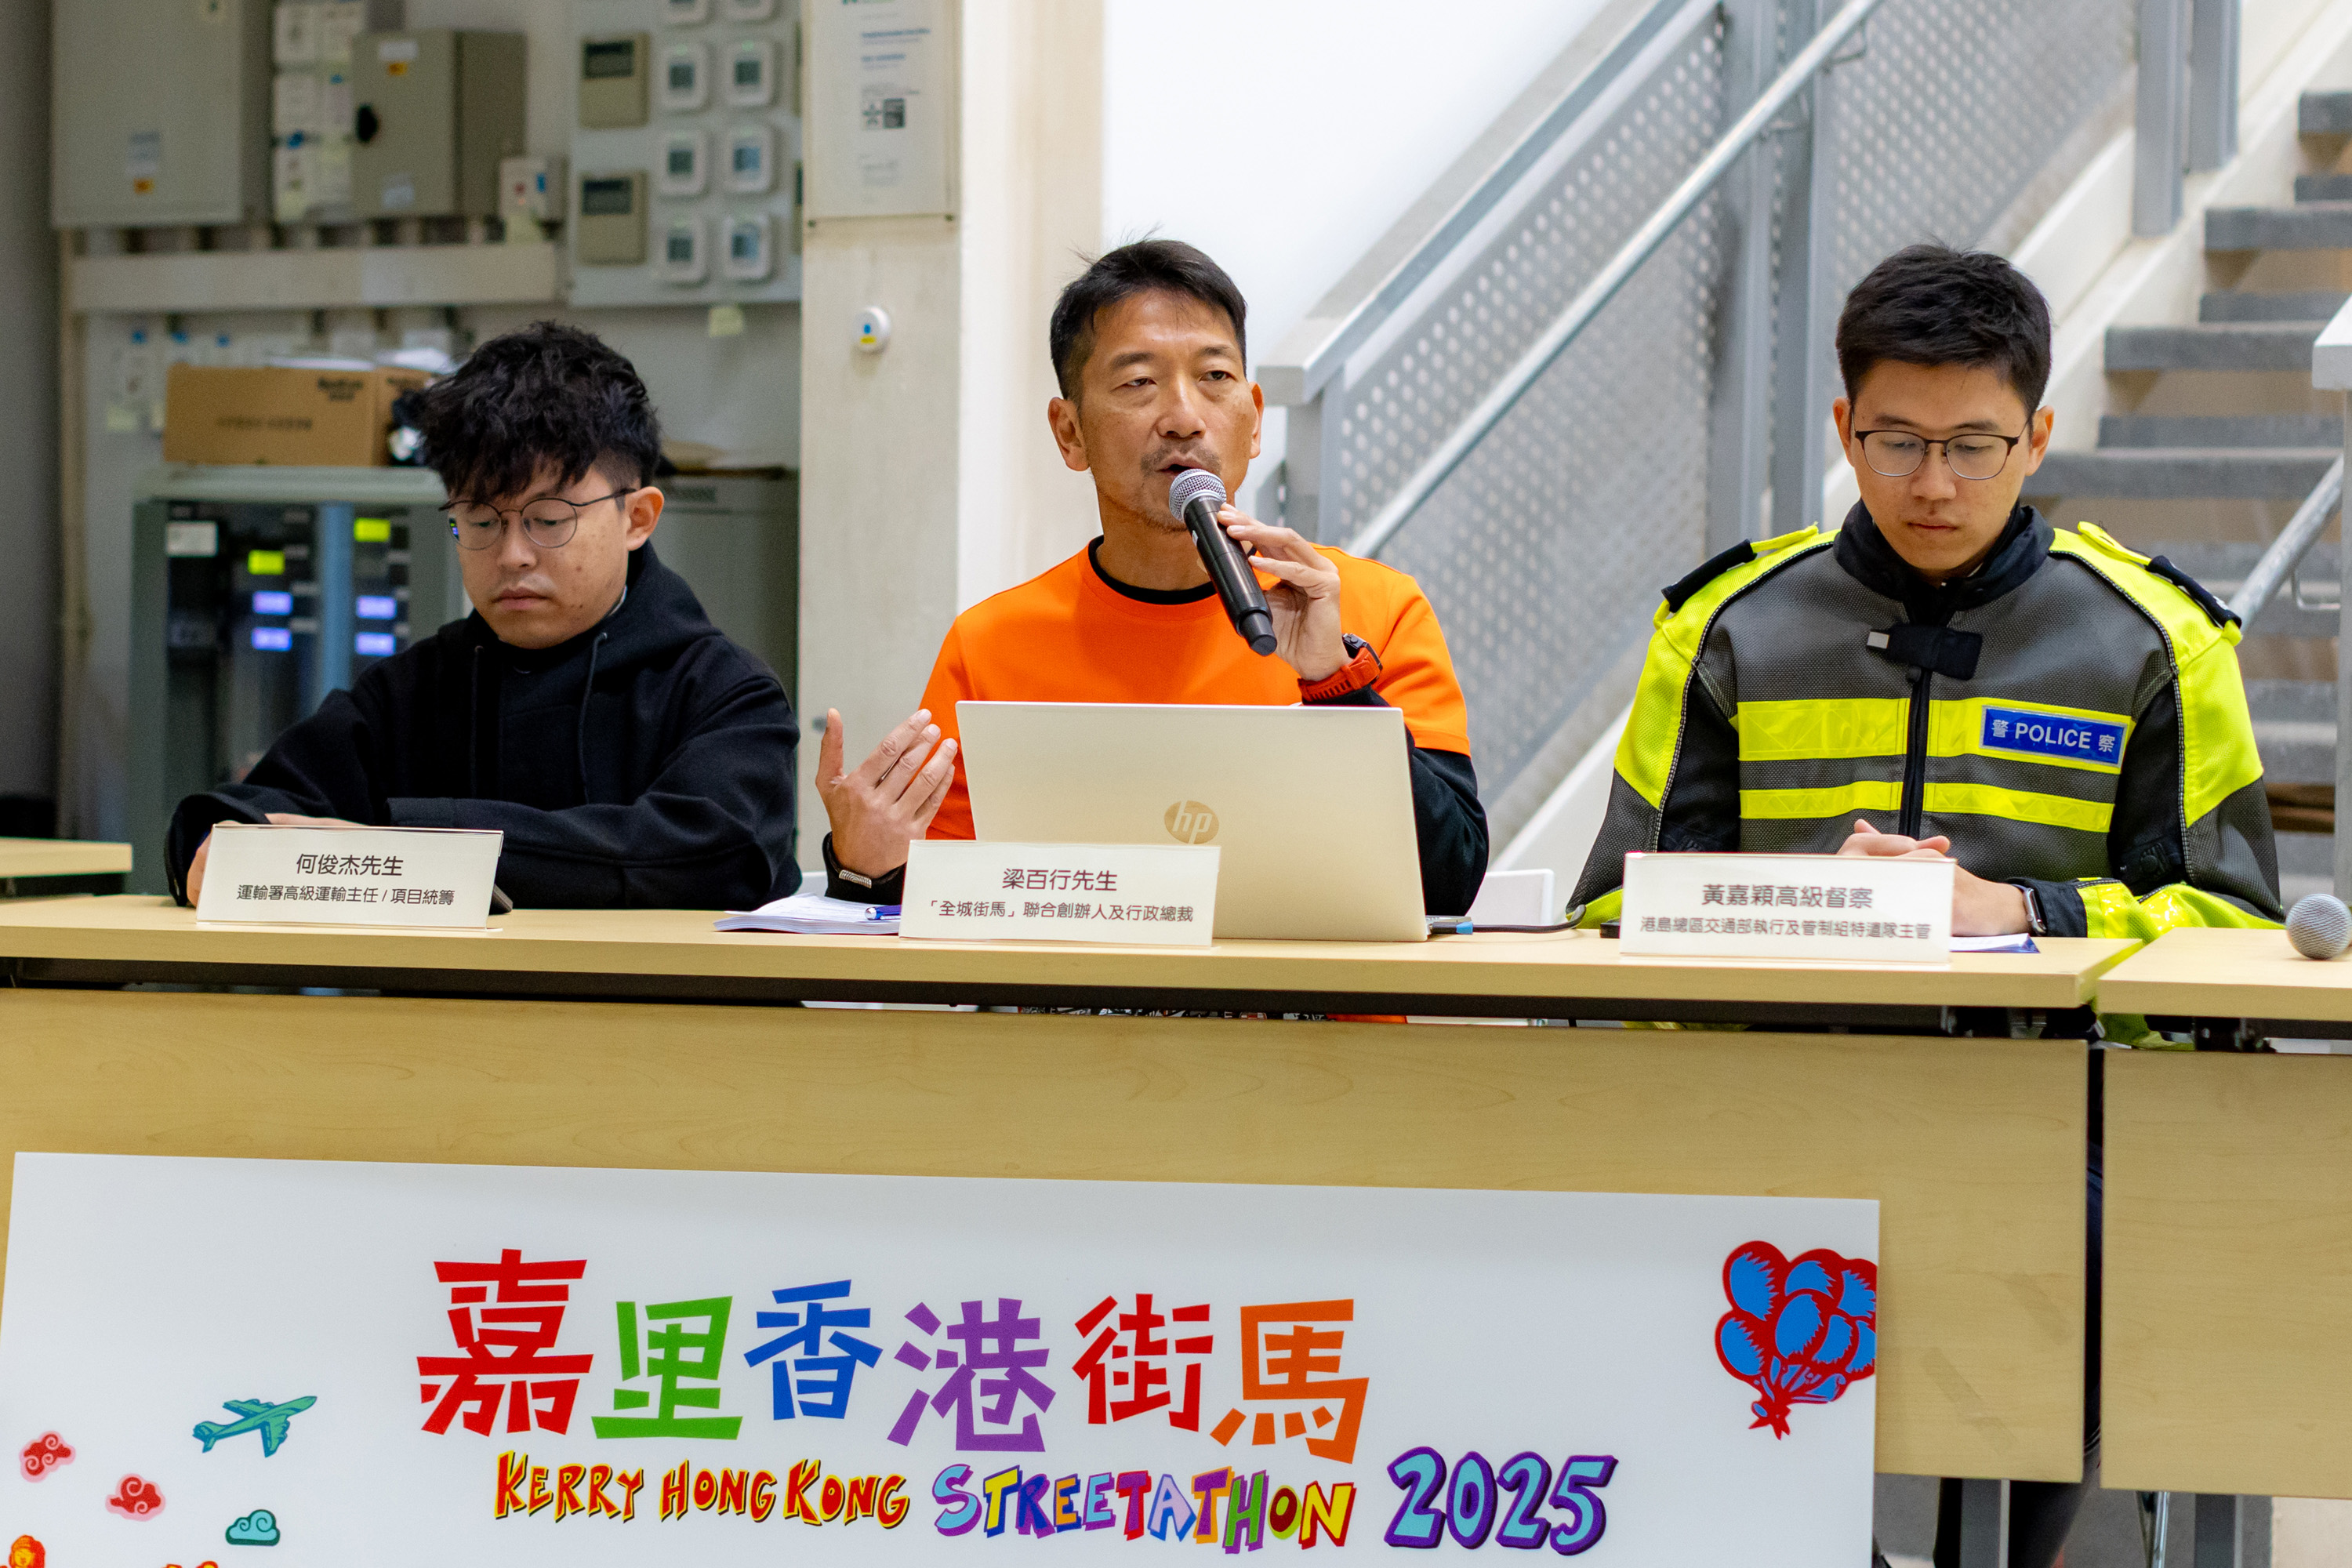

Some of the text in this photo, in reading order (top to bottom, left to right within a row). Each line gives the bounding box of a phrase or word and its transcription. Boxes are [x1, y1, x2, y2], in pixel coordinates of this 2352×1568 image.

[1992, 719, 2116, 753] 警 POLICE 察
[1172, 800, 1213, 844] hp
[296, 853, 405, 877] 何俊杰先生
[1002, 868, 1118, 892] 梁百行先生
[236, 884, 379, 904] 運輸署高級運輸主任
[390, 888, 456, 906] 項目統籌
[416, 1248, 1370, 1465] 嘉里香港街馬
[493, 1446, 1619, 1556] KERRY HONG KONG STREETATHON 2025
